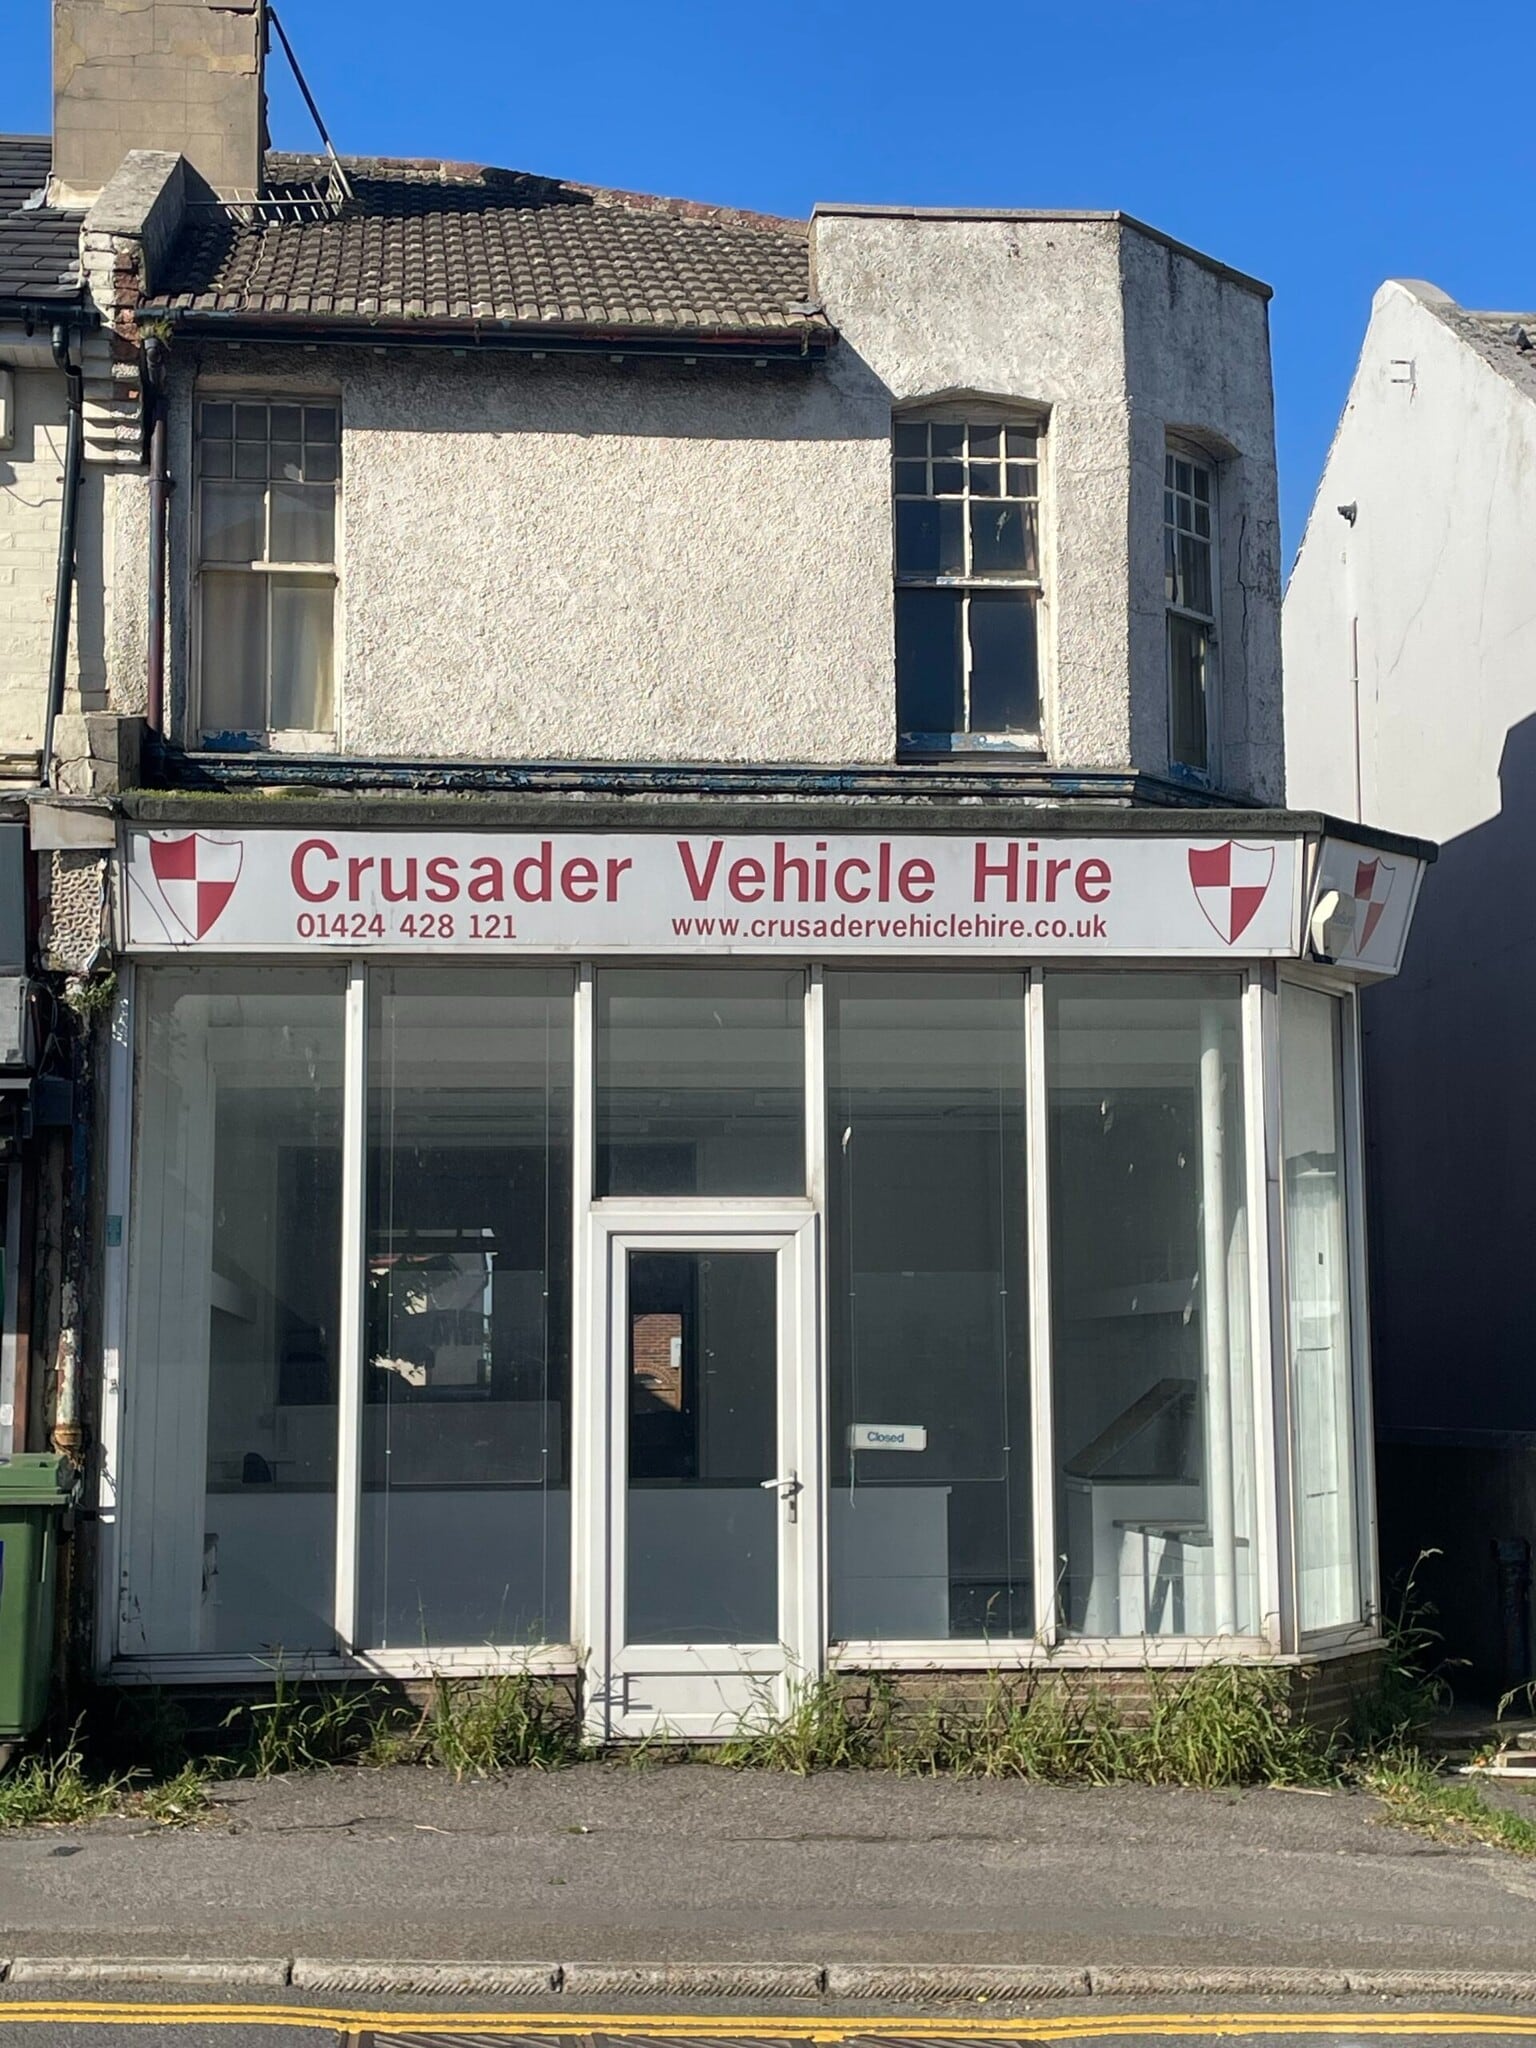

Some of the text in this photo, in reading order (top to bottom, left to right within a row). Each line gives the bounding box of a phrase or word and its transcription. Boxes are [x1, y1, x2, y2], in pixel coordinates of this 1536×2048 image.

[291, 838, 1112, 903] Crusader Vehicle Hire
[297, 913, 516, 939] 01424 428 121
[673, 914, 1106, 938] www.crusadervehiclehire.co.uk
[867, 1431, 905, 1443] Closed
